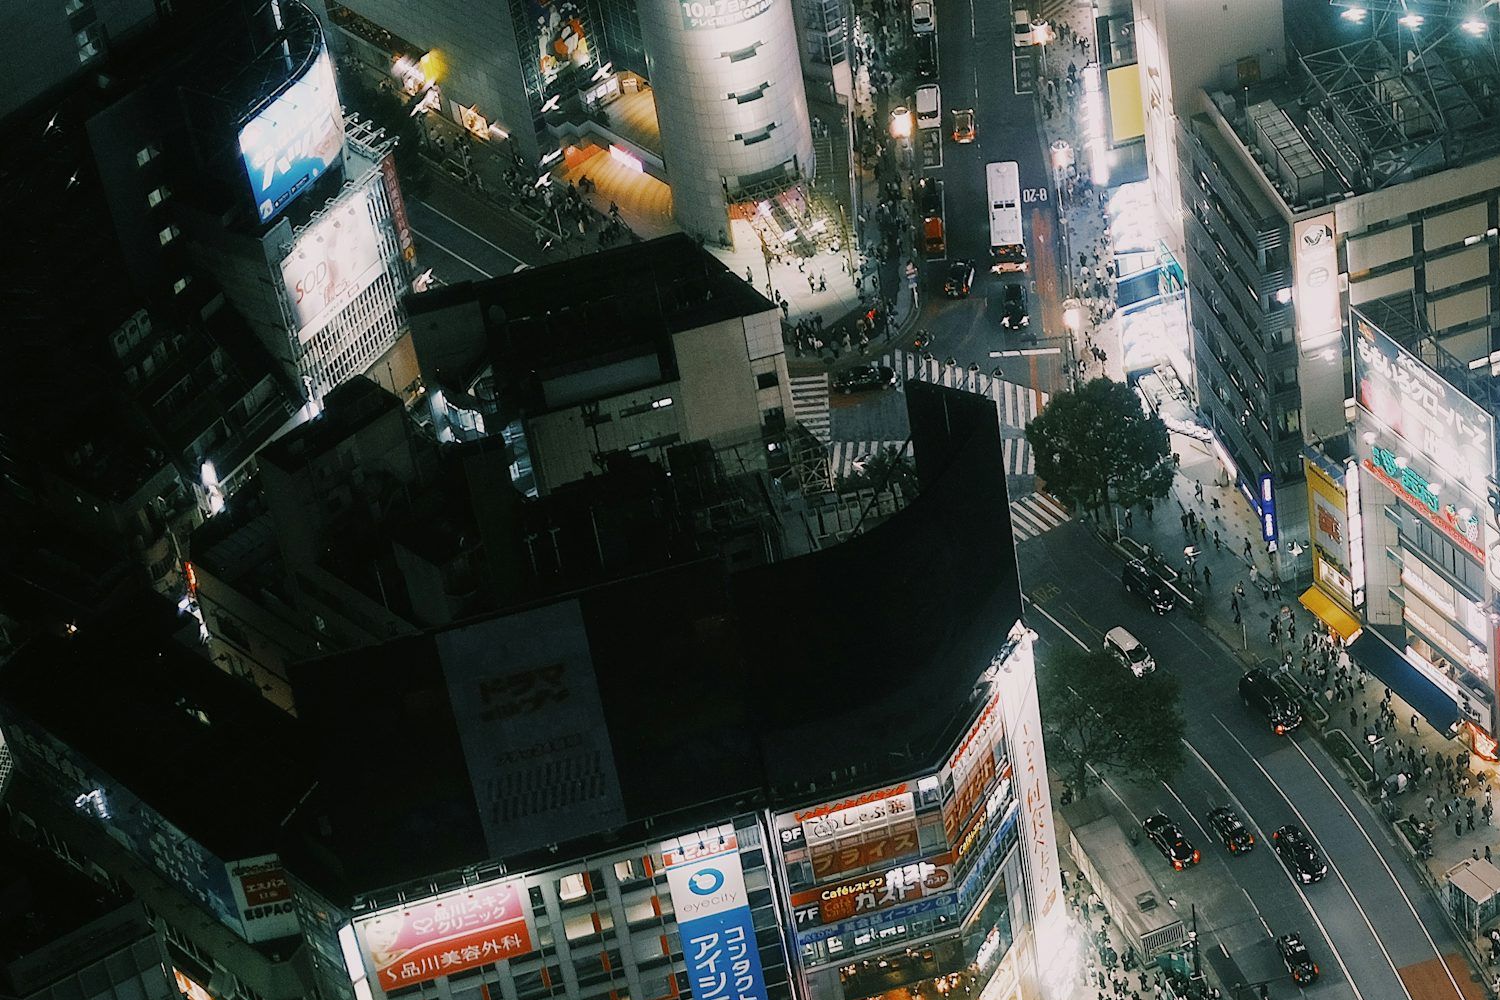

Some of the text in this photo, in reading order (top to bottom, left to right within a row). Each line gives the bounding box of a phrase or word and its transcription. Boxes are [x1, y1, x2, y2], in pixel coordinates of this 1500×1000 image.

[781, 827, 801, 843] 9F
[244, 902, 293, 921] ESPAC
[683, 891, 737, 913] eyecity
[437, 907, 506, 934] クリニック
[795, 907, 819, 923] 7F
[401, 933, 522, 979] 品川美容外科
